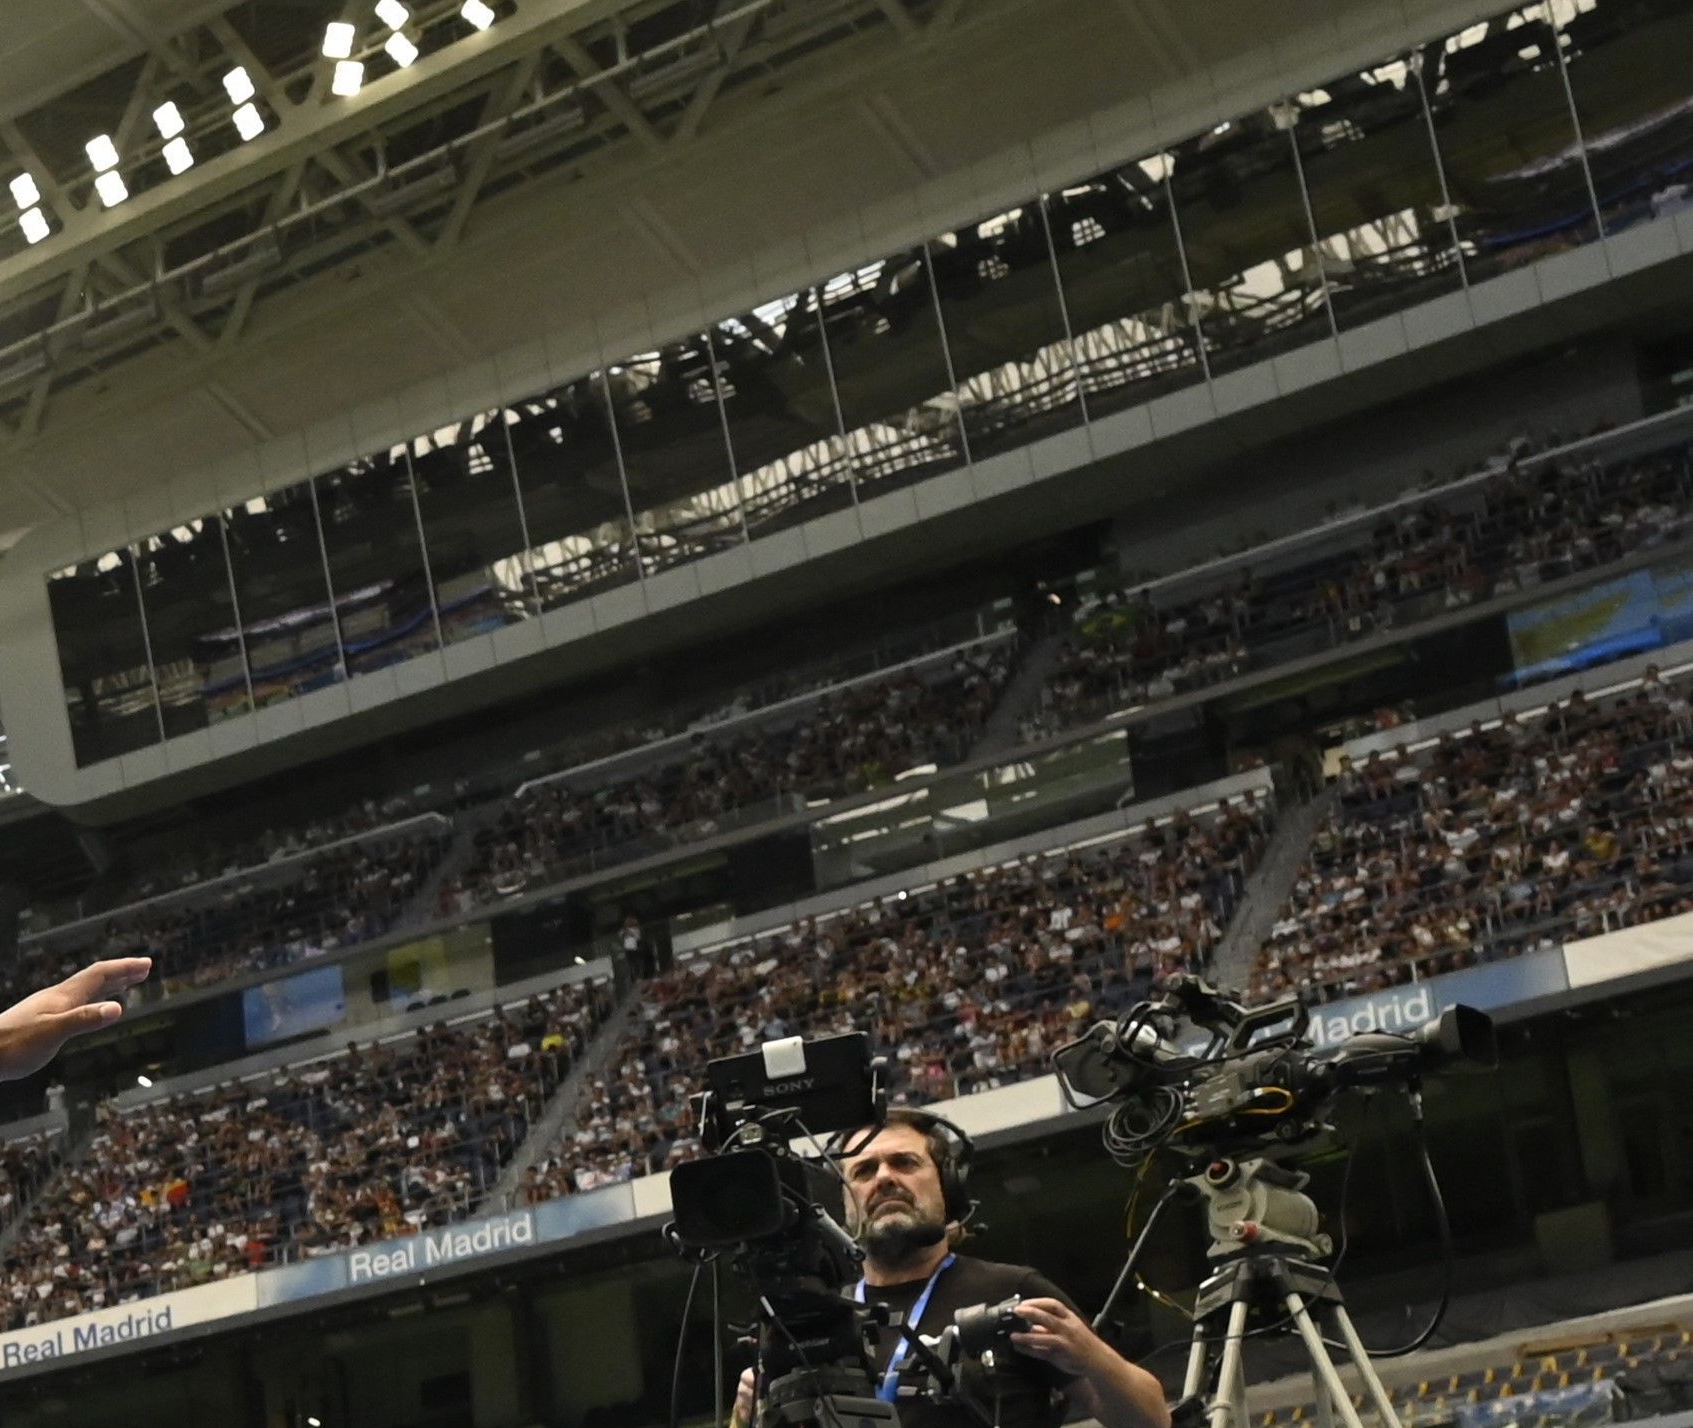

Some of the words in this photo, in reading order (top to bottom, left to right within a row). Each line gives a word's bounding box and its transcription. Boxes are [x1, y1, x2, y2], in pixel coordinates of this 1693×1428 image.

[764, 1078, 814, 1096] SONY
[350, 1243, 415, 1282] Real
[425, 1213, 532, 1265] Madrid
[3, 1331, 64, 1368] Real
[73, 1305, 172, 1350] Madrid
